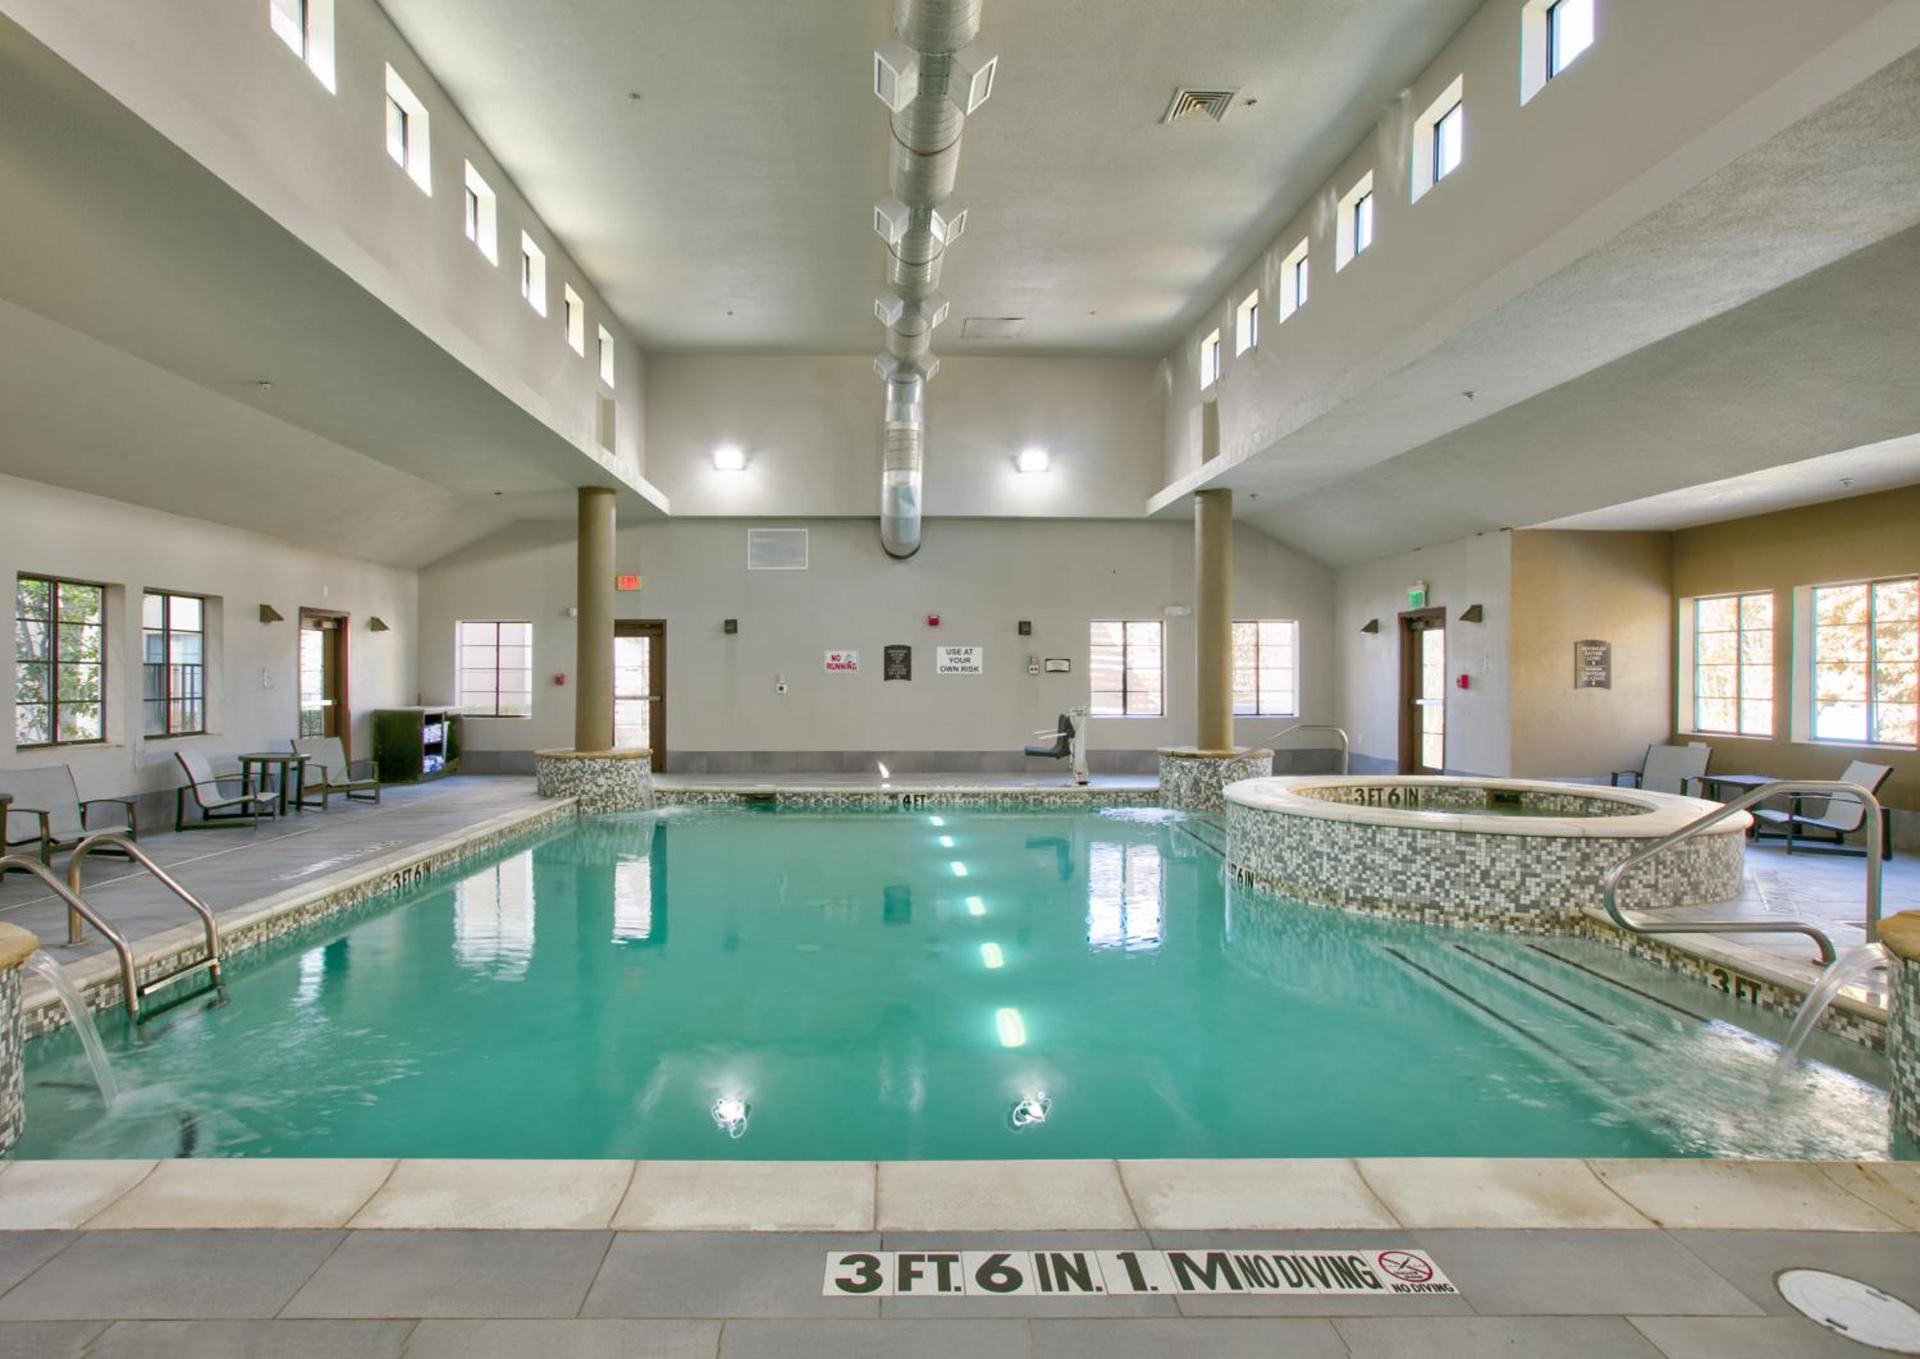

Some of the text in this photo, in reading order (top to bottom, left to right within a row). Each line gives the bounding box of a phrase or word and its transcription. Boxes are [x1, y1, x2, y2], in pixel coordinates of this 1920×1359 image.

[945, 648, 973, 656] USE AT
[831, 654, 841, 662] NO
[826, 662, 857, 670] RUNNING
[939, 665, 979, 673] OWN RISK
[903, 794, 926, 805] 4 FT
[1354, 787, 1419, 807] 3 FT 6 IN
[393, 873, 401, 891] 3
[403, 868, 411, 886] FT
[415, 865, 421, 883] 6
[1711, 968, 1762, 1004] 3 FT
[835, 1253, 883, 1293] 3
[898, 1253, 962, 1292] FT.
[975, 1253, 1024, 1293] 6
[1034, 1252, 1103, 1292] IN.
[1167, 1252, 1243, 1291] M
[1233, 1255, 1280, 1288] NO
[1271, 1255, 1384, 1290] DIVING
[1391, 1283, 1455, 1293] NO DIVING
